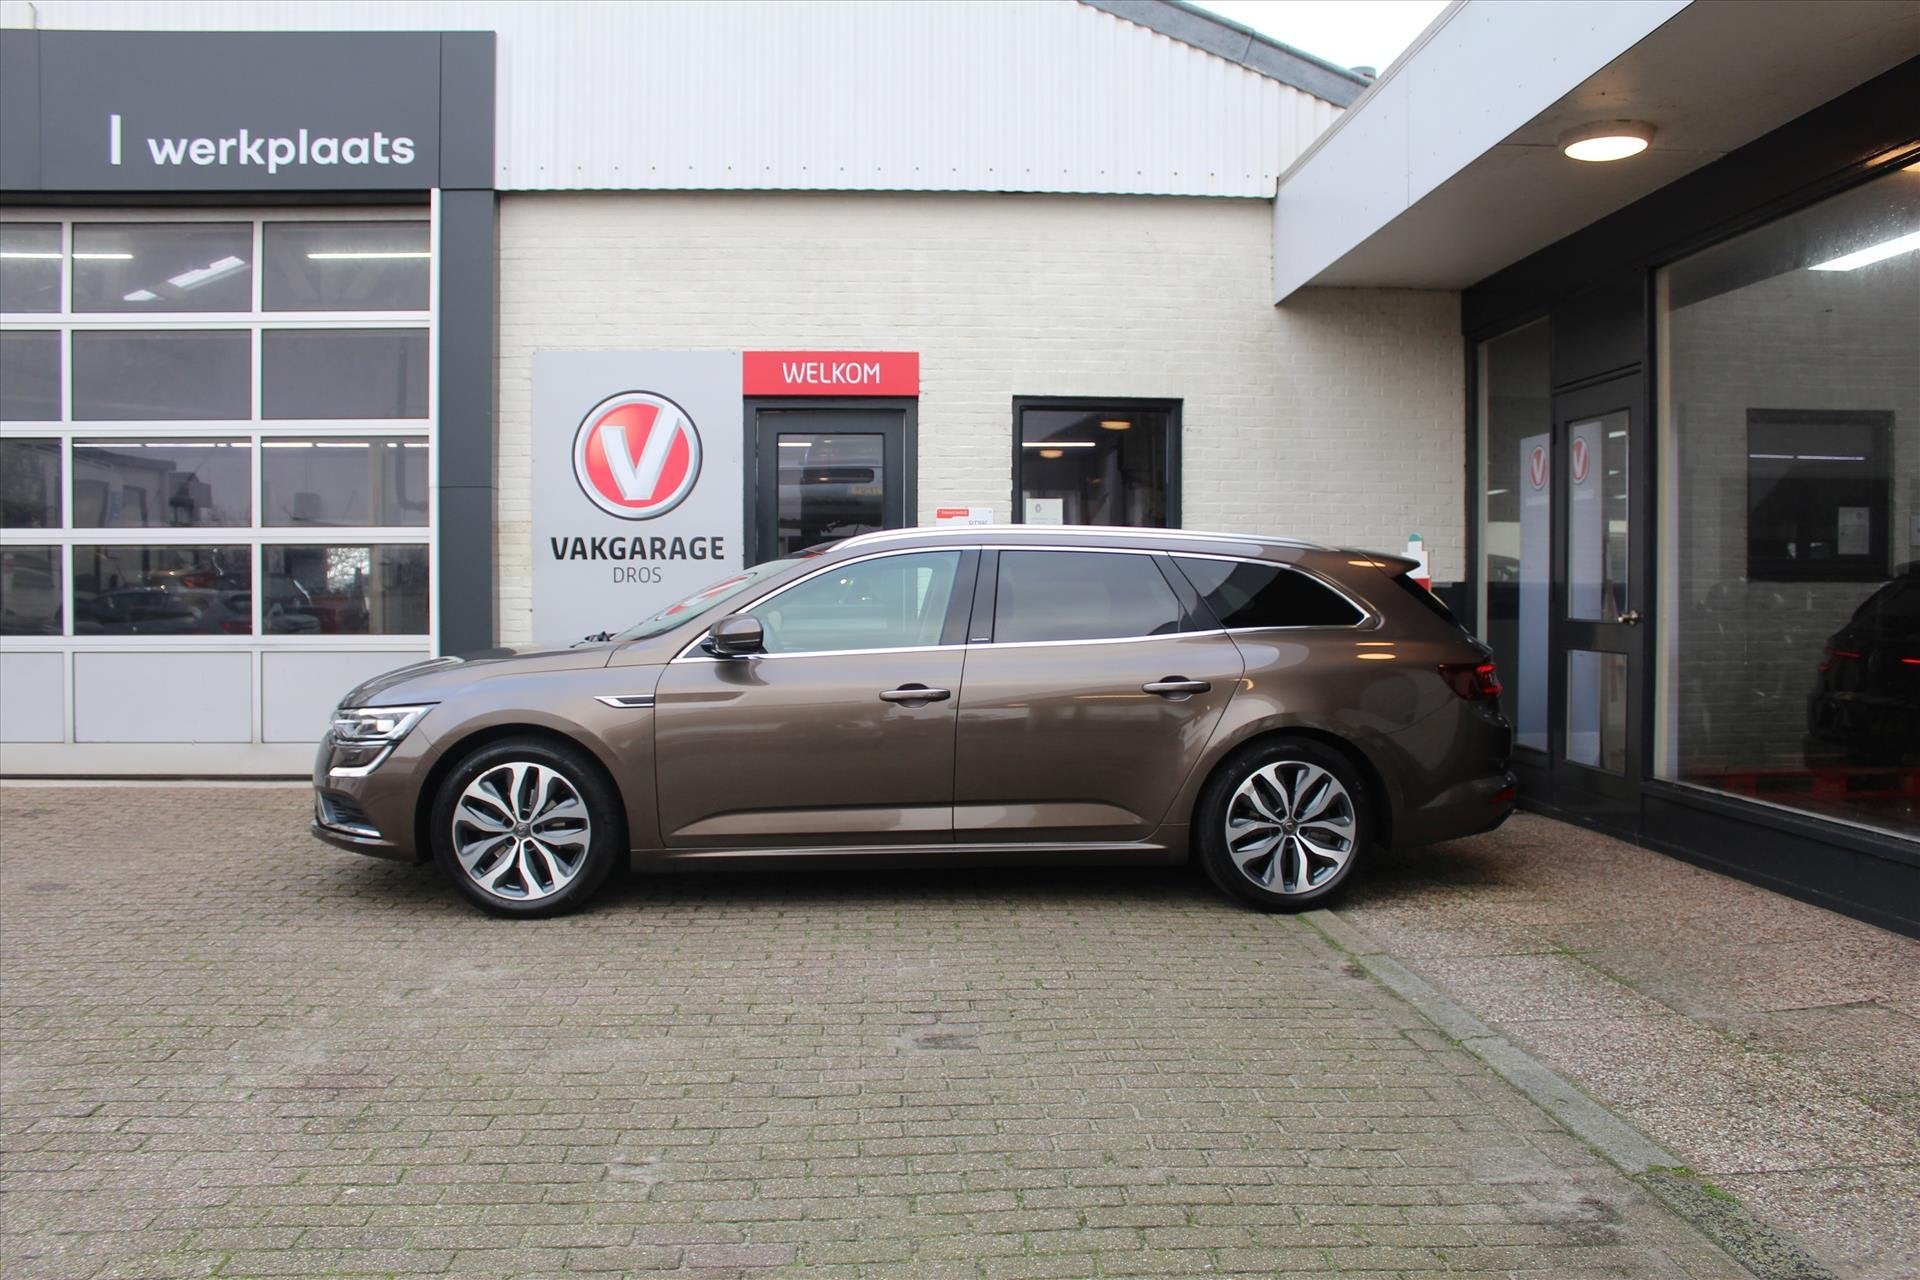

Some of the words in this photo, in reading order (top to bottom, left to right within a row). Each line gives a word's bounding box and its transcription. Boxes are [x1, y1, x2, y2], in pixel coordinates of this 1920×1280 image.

[147, 129, 415, 174] werkplaats
[782, 362, 880, 384] WELKOM
[550, 536, 725, 560] VAKGARAGE
[613, 566, 661, 584] DROS
